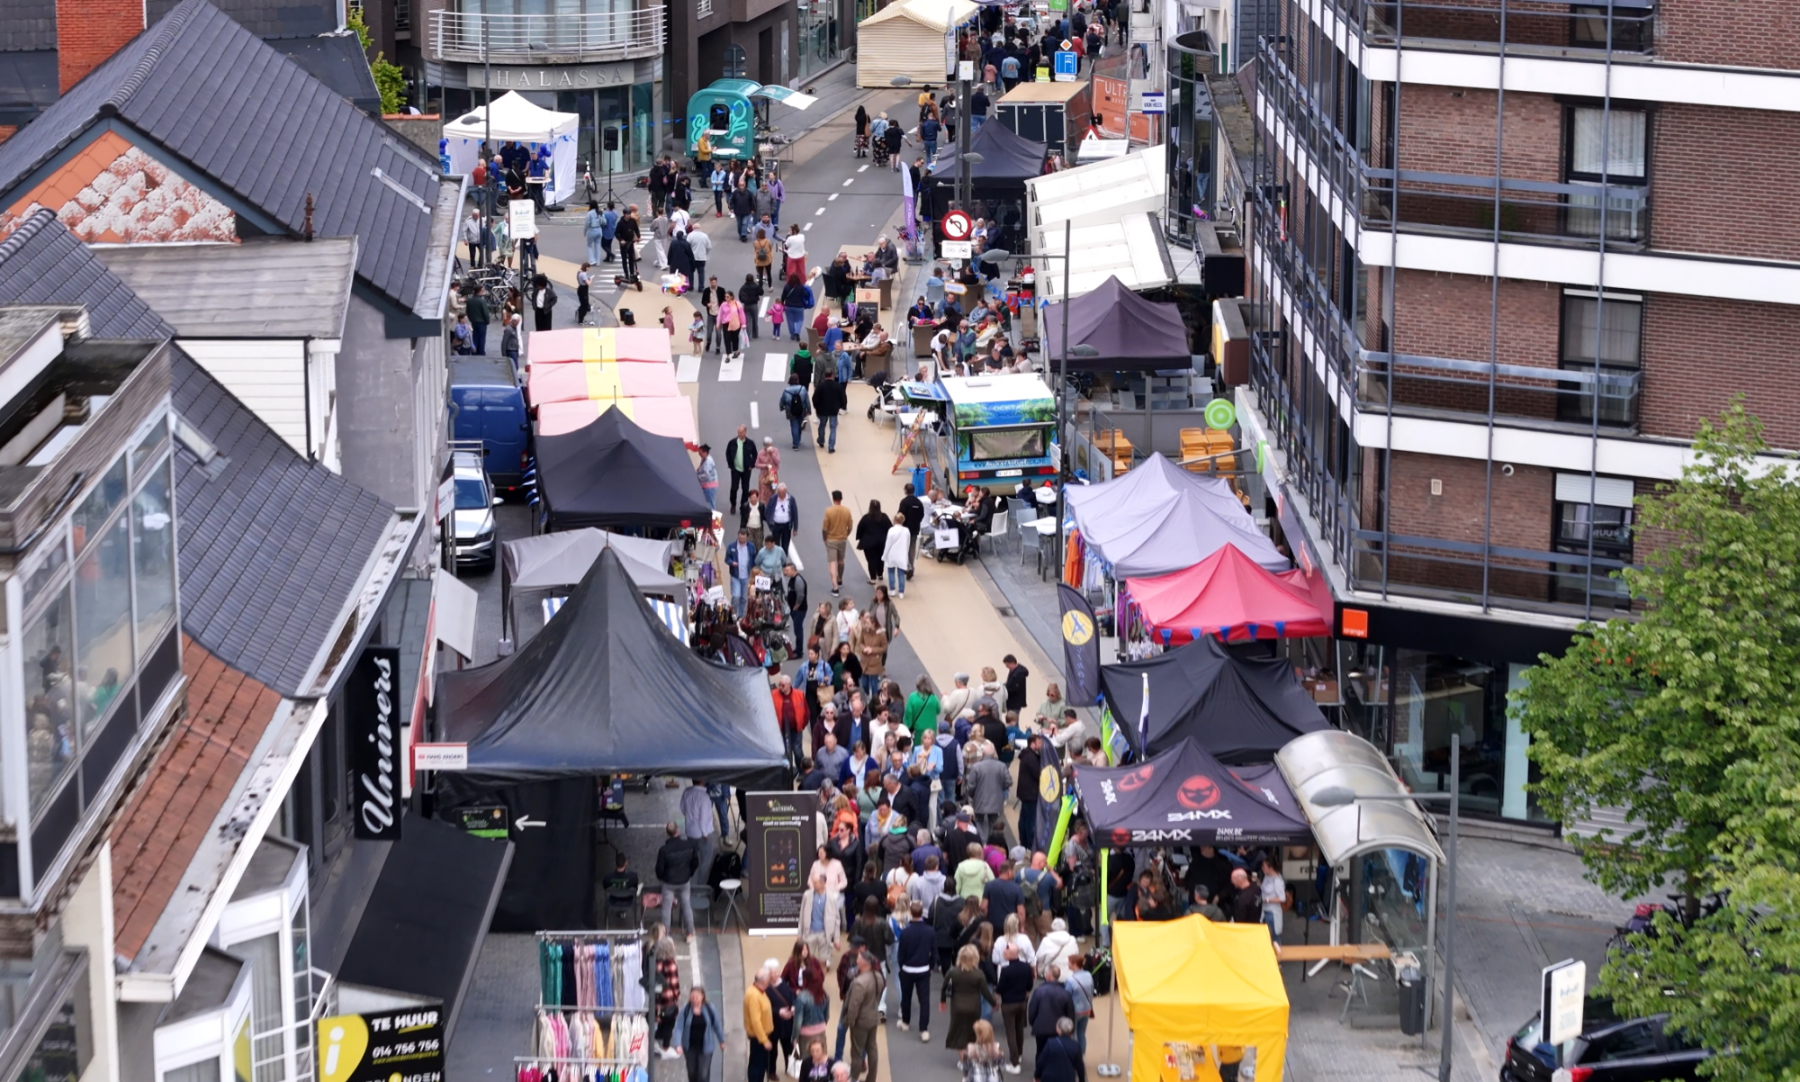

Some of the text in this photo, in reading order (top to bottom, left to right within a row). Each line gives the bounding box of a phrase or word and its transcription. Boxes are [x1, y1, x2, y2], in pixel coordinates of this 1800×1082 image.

[479, 67, 624, 87] THALASSA
[1343, 628, 1365, 637] orange
[362, 656, 393, 834] Univers
[1167, 809, 1233, 822] 24MX
[1132, 828, 1193, 842] 24MX
[371, 1011, 439, 1032] TE HUUR
[372, 1046, 393, 1059] 014
[395, 1042, 417, 1056] 756
[418, 1038, 439, 1053] 756
